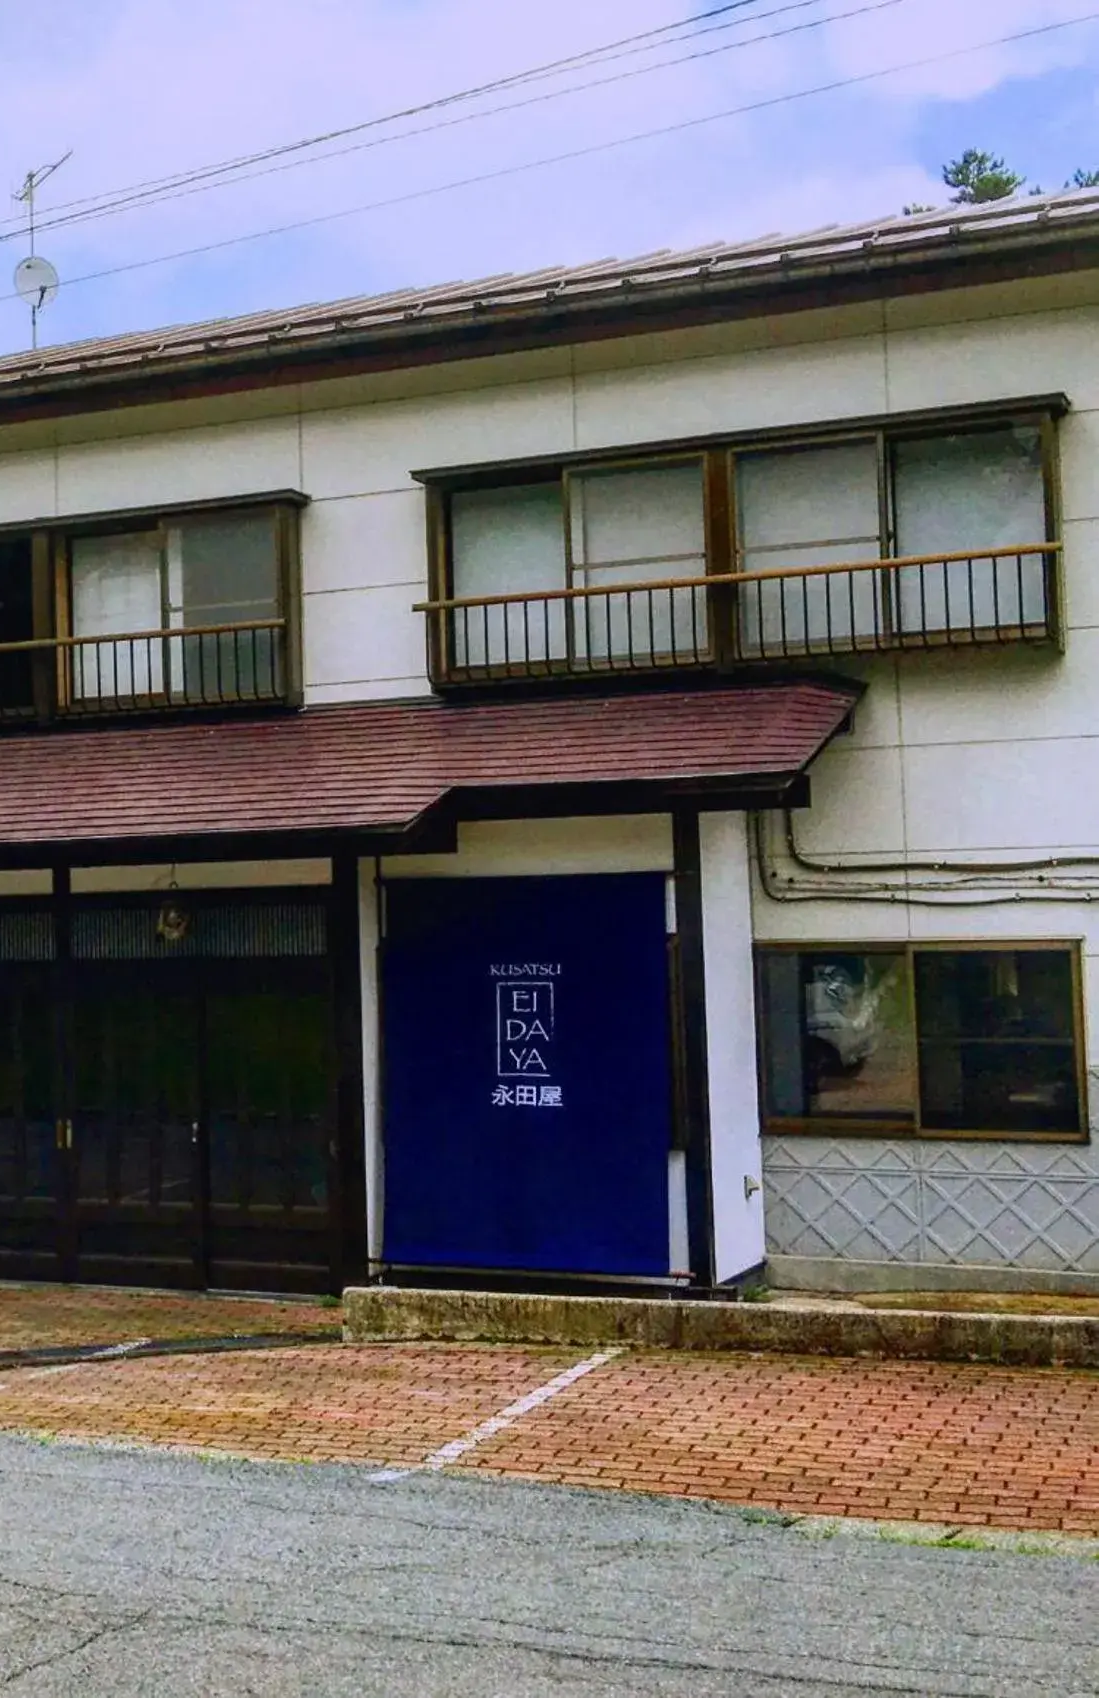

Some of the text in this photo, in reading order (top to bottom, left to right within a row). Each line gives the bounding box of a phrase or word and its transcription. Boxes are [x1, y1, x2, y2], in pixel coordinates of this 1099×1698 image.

[489, 963, 561, 976] KUSATSU
[512, 990, 537, 1012] EI
[506, 1019, 550, 1042] DA
[509, 1048, 547, 1070] YA
[491, 1084, 563, 1107] 永田屋
